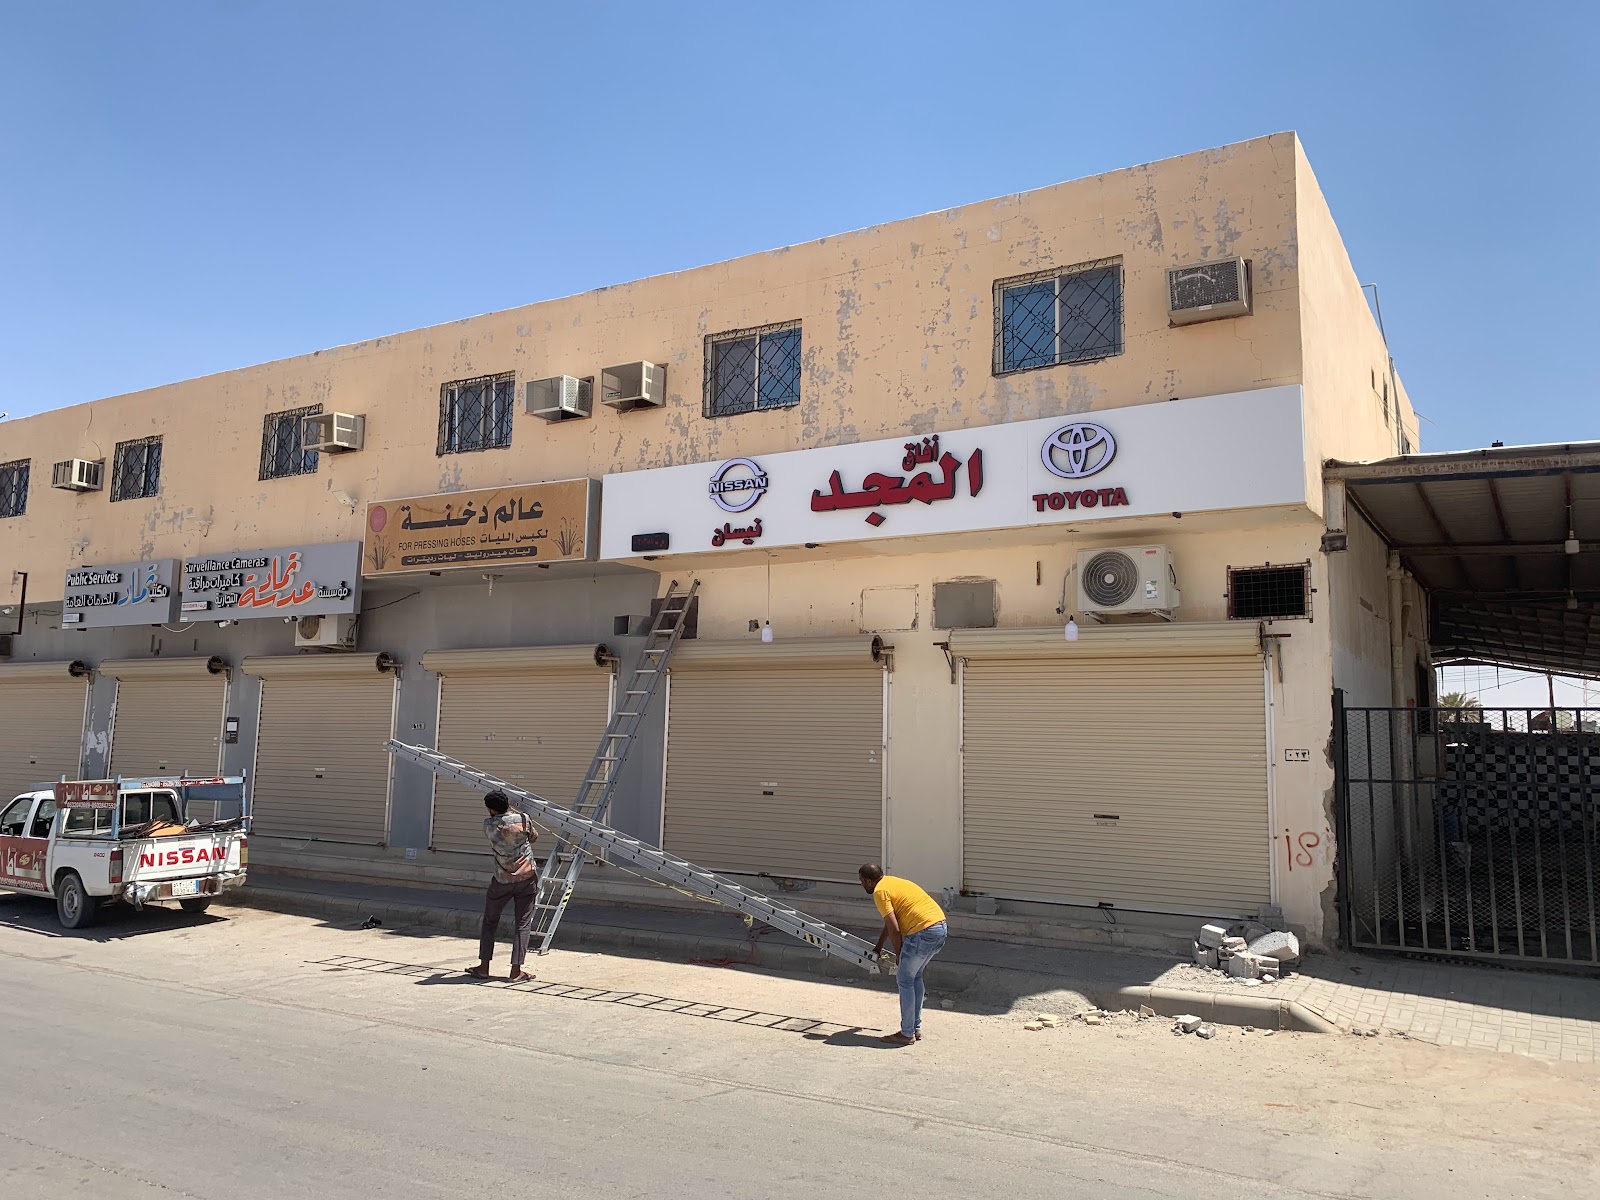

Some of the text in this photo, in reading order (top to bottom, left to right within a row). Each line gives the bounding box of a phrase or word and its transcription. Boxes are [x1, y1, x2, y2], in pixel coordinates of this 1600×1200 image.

[708, 477, 769, 493] NISSAN
[810, 447, 983, 528] المجد
[1032, 487, 1130, 512] TOYOTA
[400, 496, 544, 531] عالم دخنة
[480, 528, 549, 545] لكبس الليات
[711, 517, 763, 547] نيسان
[398, 536, 476, 551] FOR PRESSING HOSES
[184, 557, 266, 573] Surveillance Cameras
[66, 570, 119, 586] Public Services
[187, 573, 240, 593] كاميرات مراقبة
[148, 583, 168, 602] مكتب
[318, 580, 349, 600] مؤسسة
[65, 592, 116, 609] للخدمات العامة
[215, 592, 239, 608] التجارية
[140, 846, 226, 868] NISSAN
